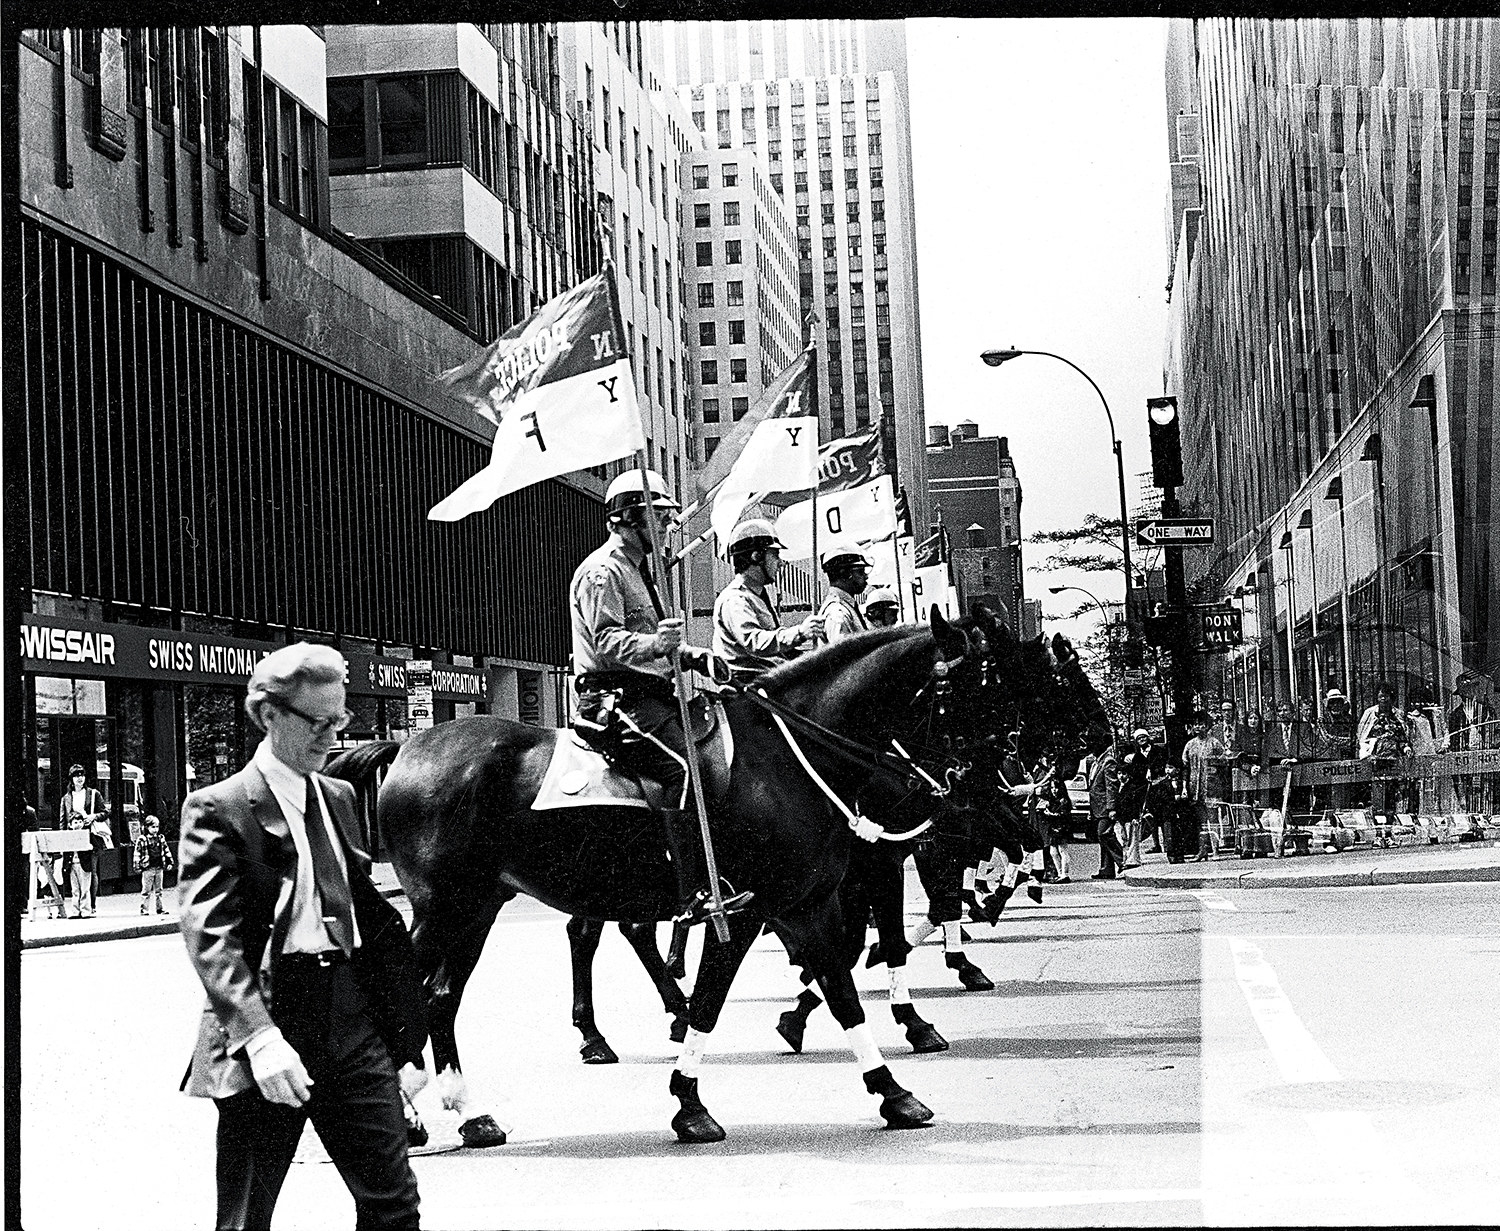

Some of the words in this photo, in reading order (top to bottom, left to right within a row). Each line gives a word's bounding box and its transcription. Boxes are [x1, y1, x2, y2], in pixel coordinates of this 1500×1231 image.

[1147, 527, 1170, 538] ONE
[1184, 527, 1207, 537] WAY
[1205, 631, 1239, 642] WALK
[149, 639, 193, 671] SWISS
[378, 664, 405, 689] SWISS
[431, 670, 480, 695] CORPORATION
